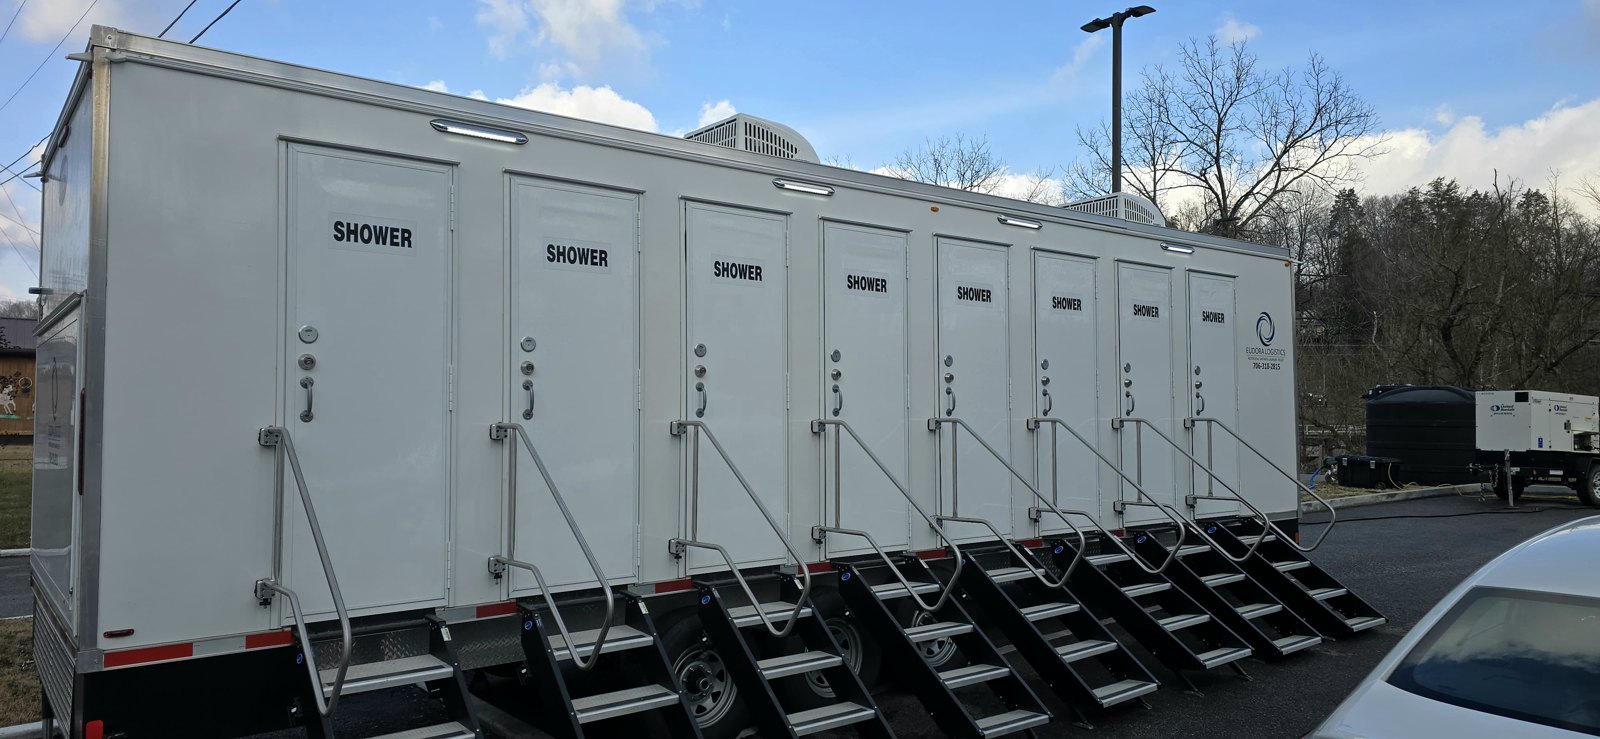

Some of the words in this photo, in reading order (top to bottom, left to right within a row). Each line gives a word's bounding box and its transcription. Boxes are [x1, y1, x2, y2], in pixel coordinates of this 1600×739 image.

[334, 221, 412, 248] SHOWER
[547, 244, 607, 267] SHOWER
[714, 261, 762, 281] SHOWER
[847, 275, 886, 292] SHOWER
[958, 286, 991, 302] SHOWER
[1053, 296, 1081, 311] SHOWER
[1134, 304, 1159, 317] SHOWER
[1203, 311, 1224, 323] SHOWER
[1265, 348, 1286, 356] LOGISTICS
